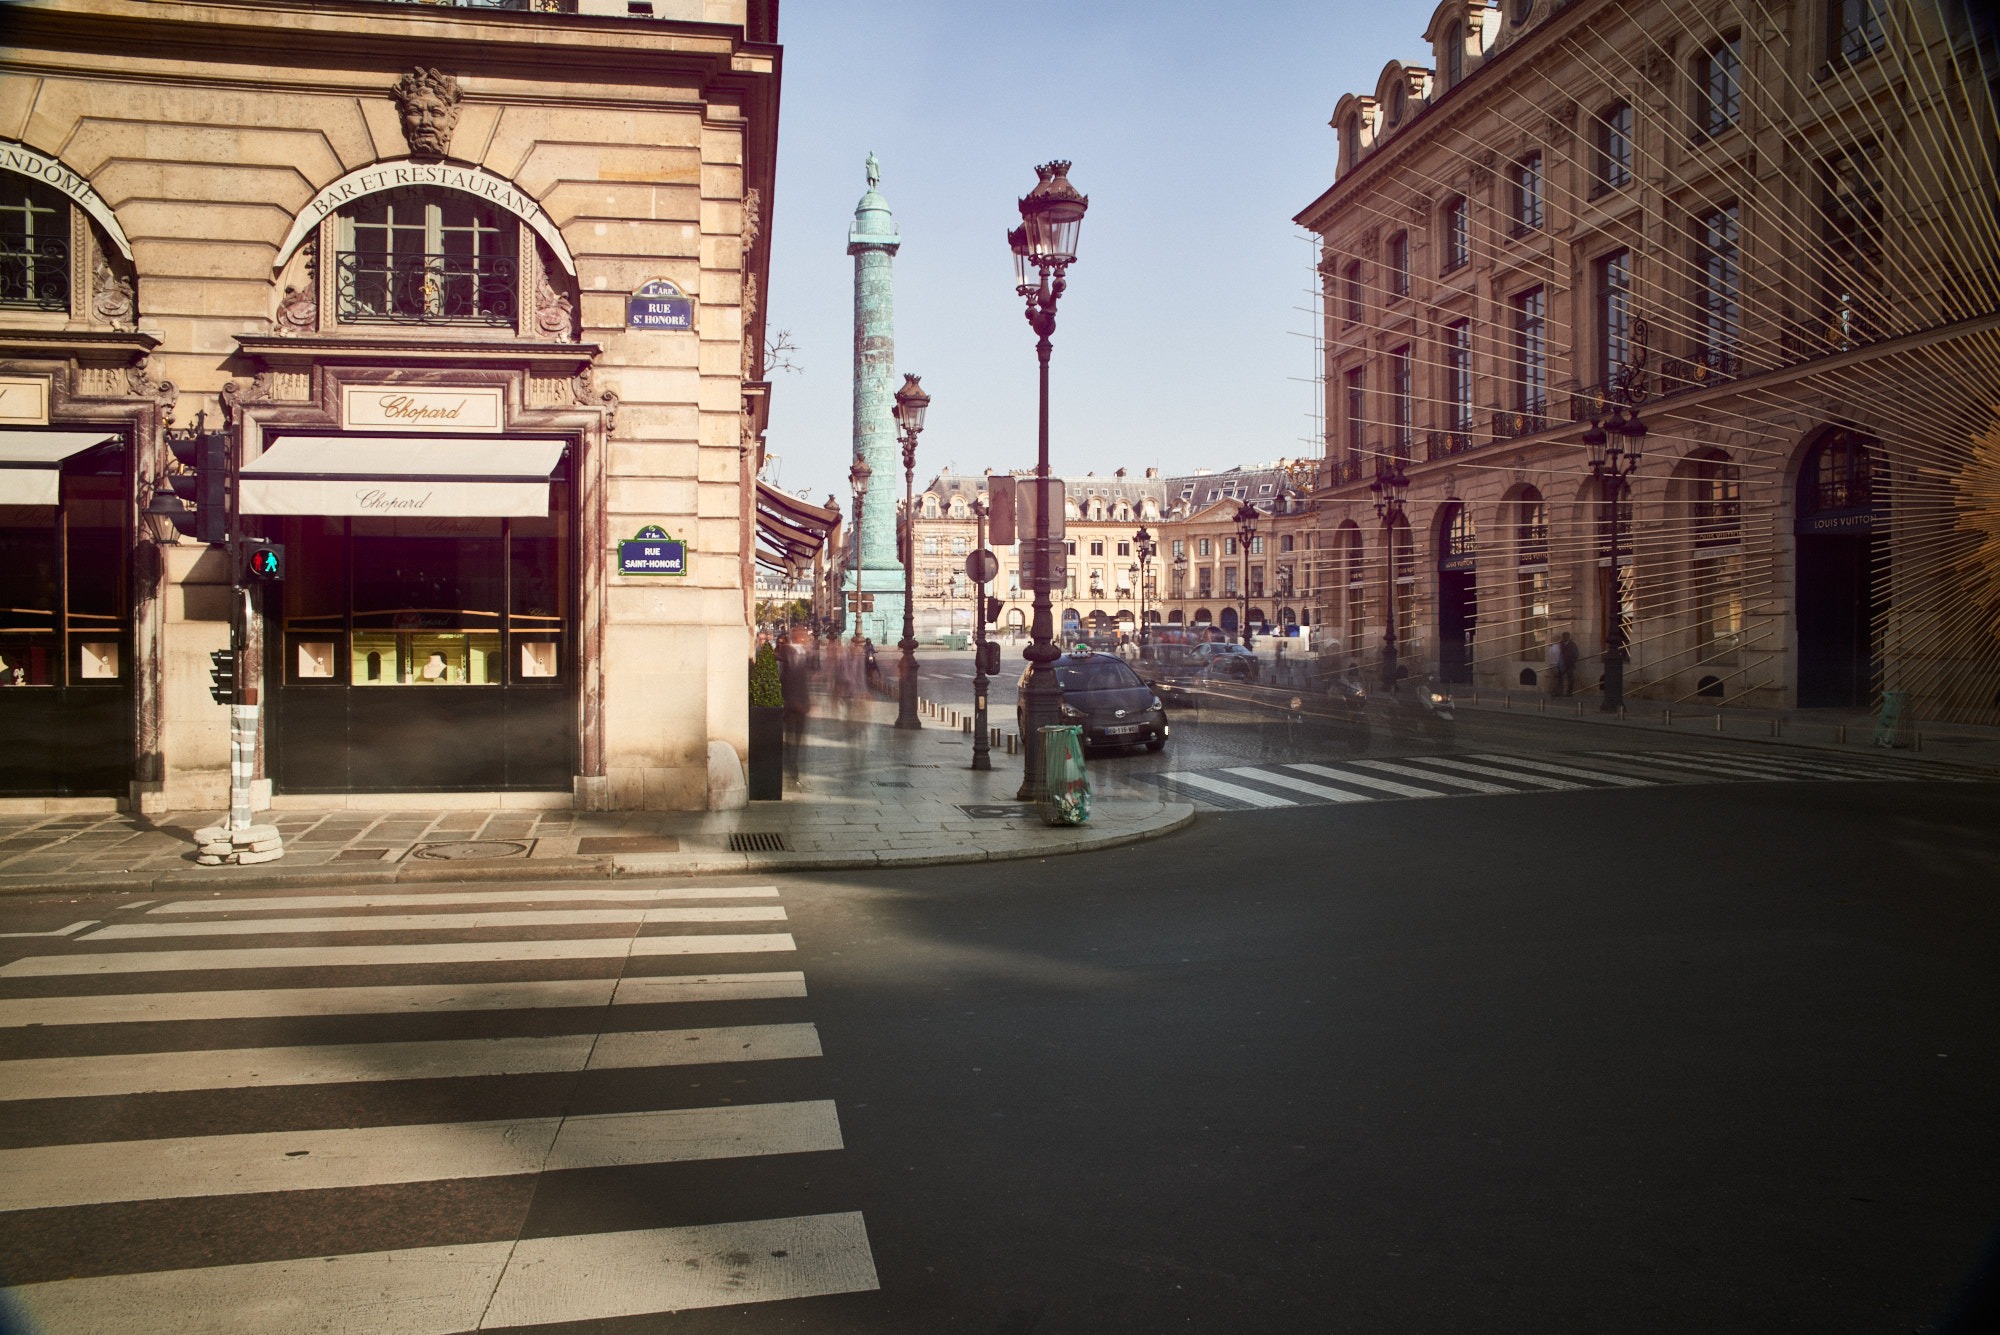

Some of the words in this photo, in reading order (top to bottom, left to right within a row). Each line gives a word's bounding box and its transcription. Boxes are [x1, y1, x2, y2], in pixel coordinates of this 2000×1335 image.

[312, 183, 357, 216] BAR
[360, 171, 388, 191] ET
[395, 167, 542, 220] RESTAURANT
[648, 303, 671, 313] RUE
[379, 394, 467, 423] Chopard
[355, 488, 432, 512] Chopard
[1814, 518, 1838, 529] LOUIS
[1840, 514, 1878, 526] VUITTON
[644, 547, 661, 556] RUE
[625, 558, 681, 569] SAINT-HONORÉ
